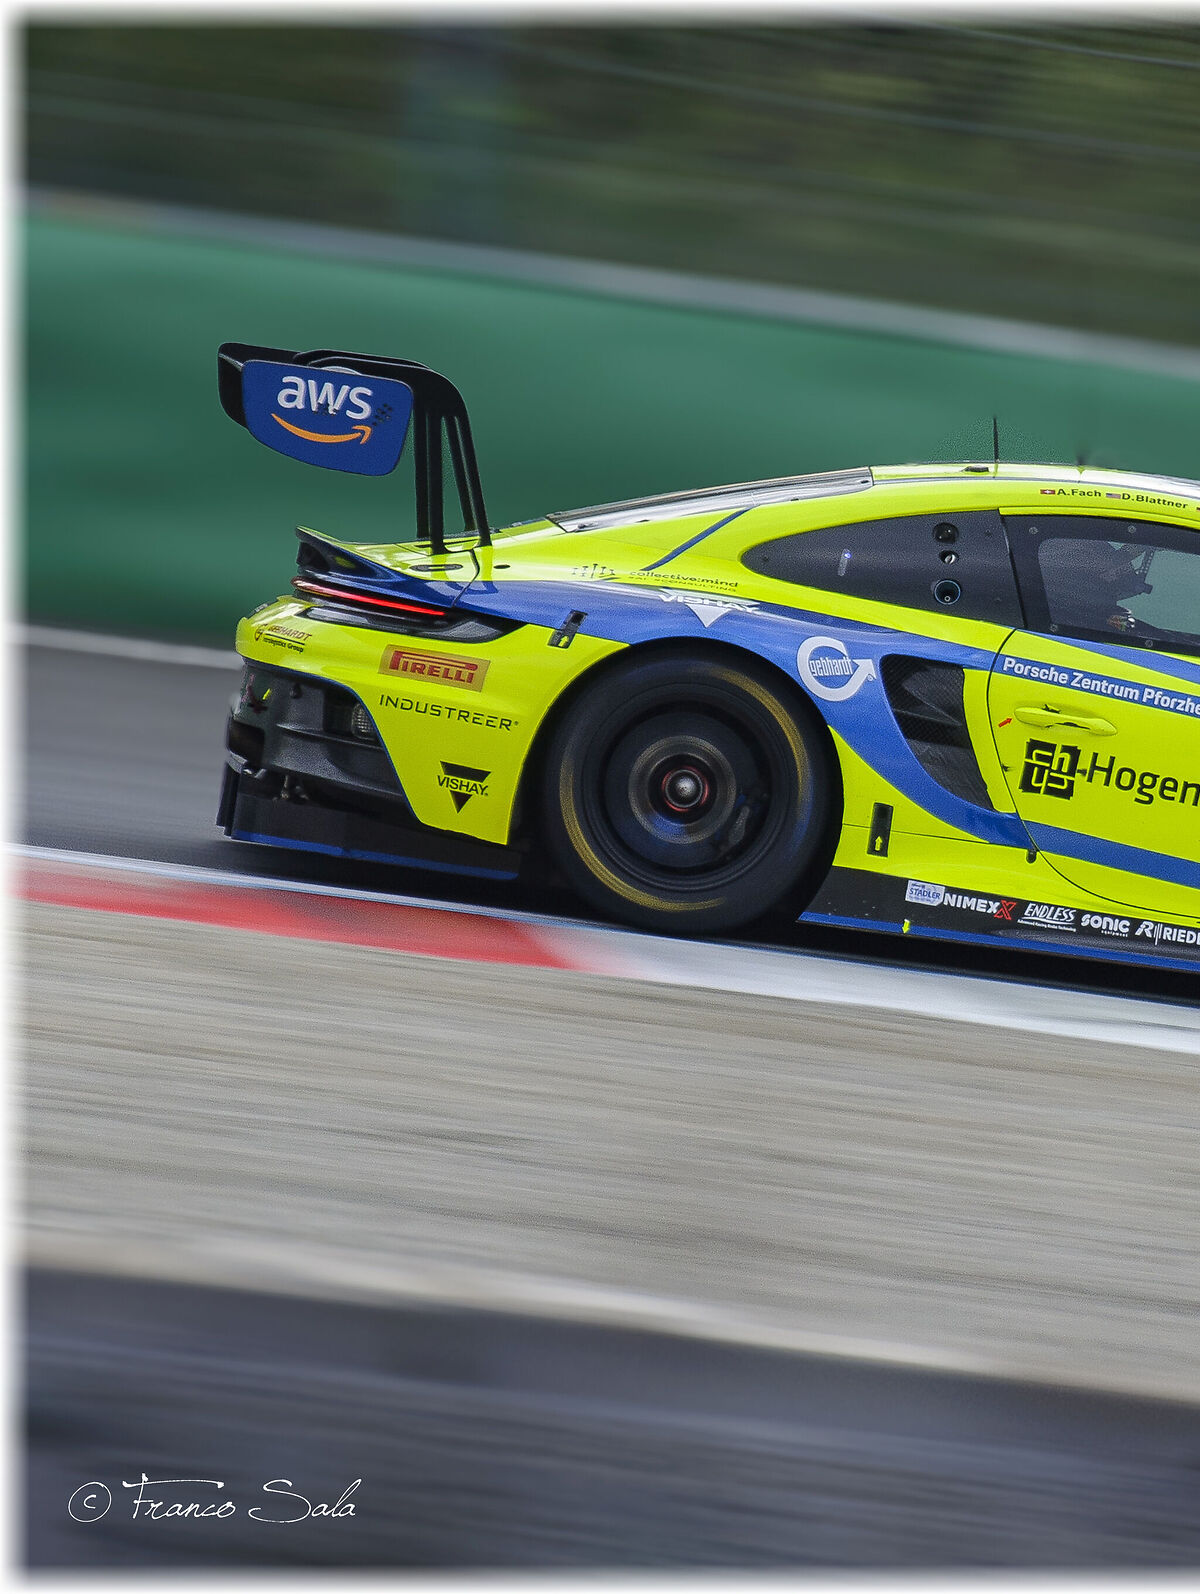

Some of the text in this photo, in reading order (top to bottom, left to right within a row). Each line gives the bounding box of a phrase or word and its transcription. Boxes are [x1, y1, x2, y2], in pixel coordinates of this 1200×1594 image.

[277, 376, 373, 420] aws
[1057, 488, 1102, 497] A.Fach
[1121, 493, 1188, 509] D.Blattner
[389, 650, 479, 684] PIRELLI
[810, 656, 853, 677] gebhardt
[1003, 657, 1068, 684] Porsche
[1070, 671, 1139, 700] Zentrum
[437, 775, 488, 796] VISHAY
[909, 887, 941, 900] STADLER
[1024, 902, 1077, 922] ENDLESS
